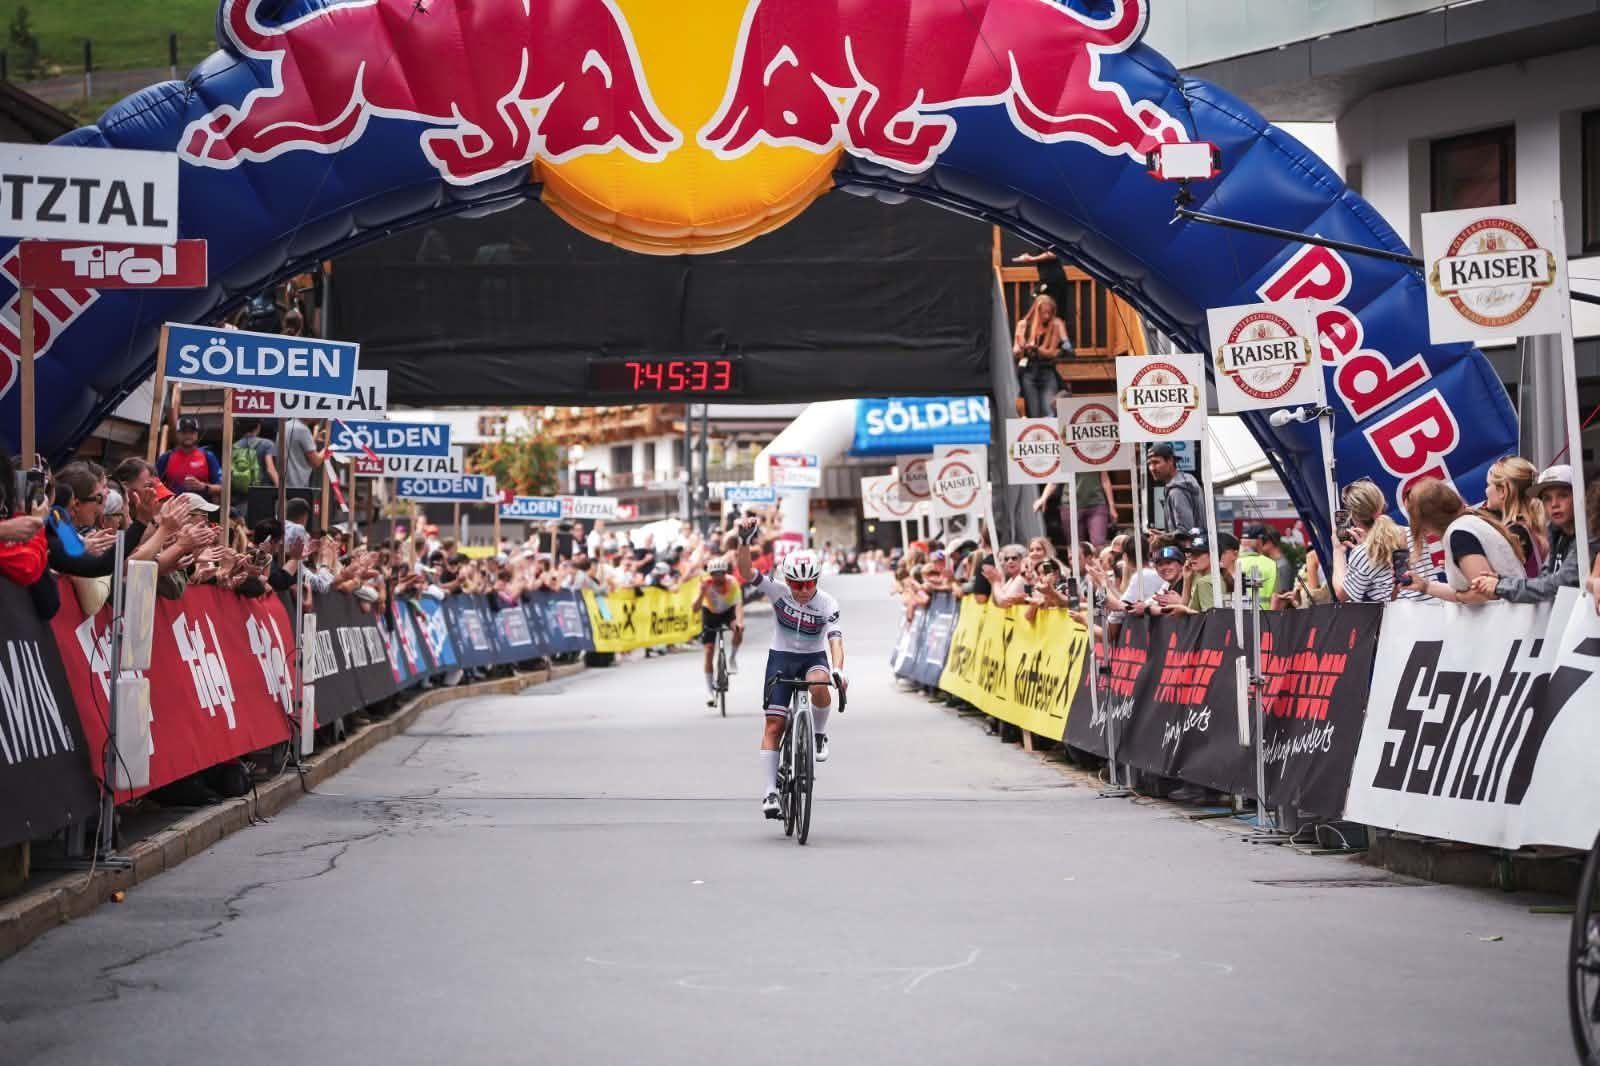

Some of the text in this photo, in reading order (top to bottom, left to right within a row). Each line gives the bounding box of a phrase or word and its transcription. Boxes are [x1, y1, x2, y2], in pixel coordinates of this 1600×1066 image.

[0, 174, 168, 228] TZTAL
[61, 245, 177, 284] Tirol
[1450, 255, 1538, 285] KAISER
[179, 337, 341, 378] SÖLDEN
[1231, 341, 1298, 366] KAISER
[625, 361, 731, 391] 7:45:33
[235, 396, 273, 409] TAL
[1134, 387, 1189, 406] KAISER
[866, 397, 991, 436] SÖLDEN
[337, 424, 441, 450] SÖLDEN
[1071, 424, 1119, 440] KAISER
[1018, 443, 1060, 457] KAISER
[940, 476, 975, 490] KAISER
